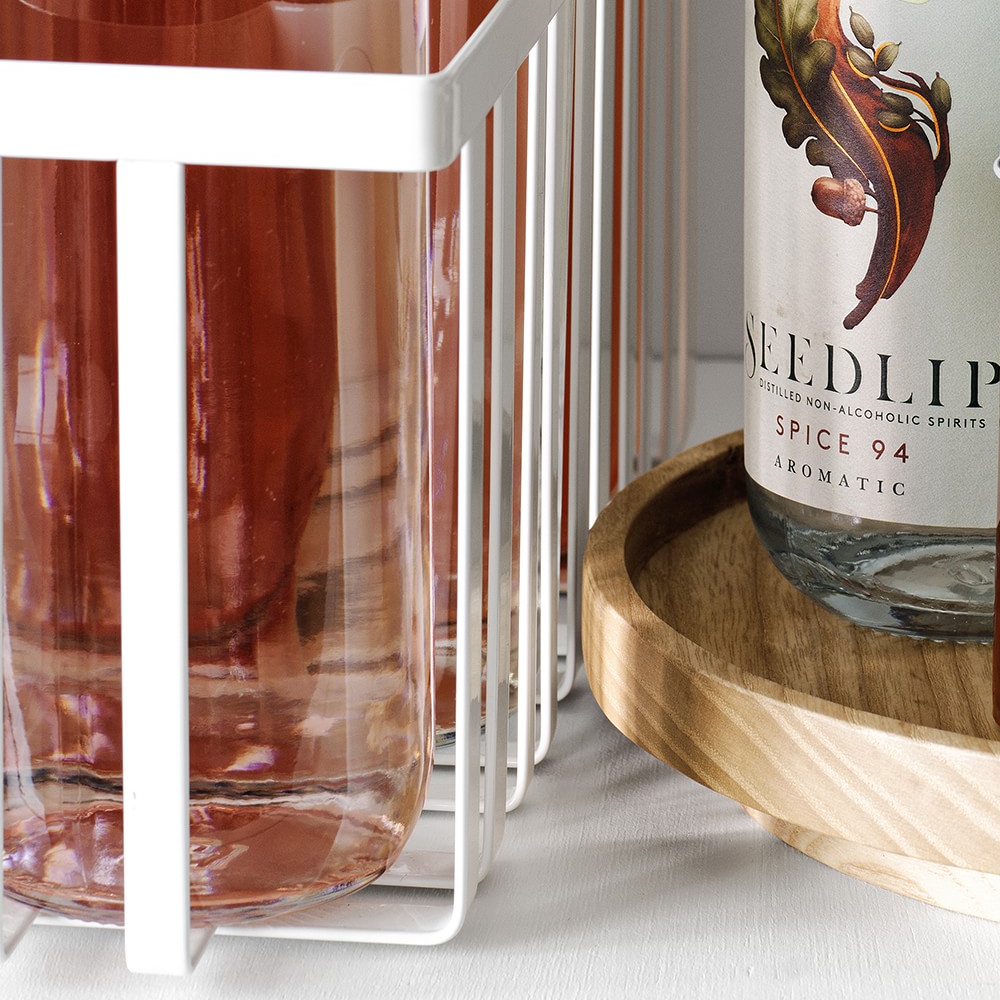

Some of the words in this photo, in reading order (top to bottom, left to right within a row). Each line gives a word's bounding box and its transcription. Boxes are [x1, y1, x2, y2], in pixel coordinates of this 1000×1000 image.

[745, 311, 1000, 409] SEEDLIP
[759, 377, 802, 403] DISTILLED
[806, 397, 921, 426] NON-ALCOHOLIC
[928, 416, 986, 429] SPIRITS
[775, 415, 850, 455] SPICE
[872, 439, 909, 463] 94
[774, 454, 905, 496] AROMATIC
